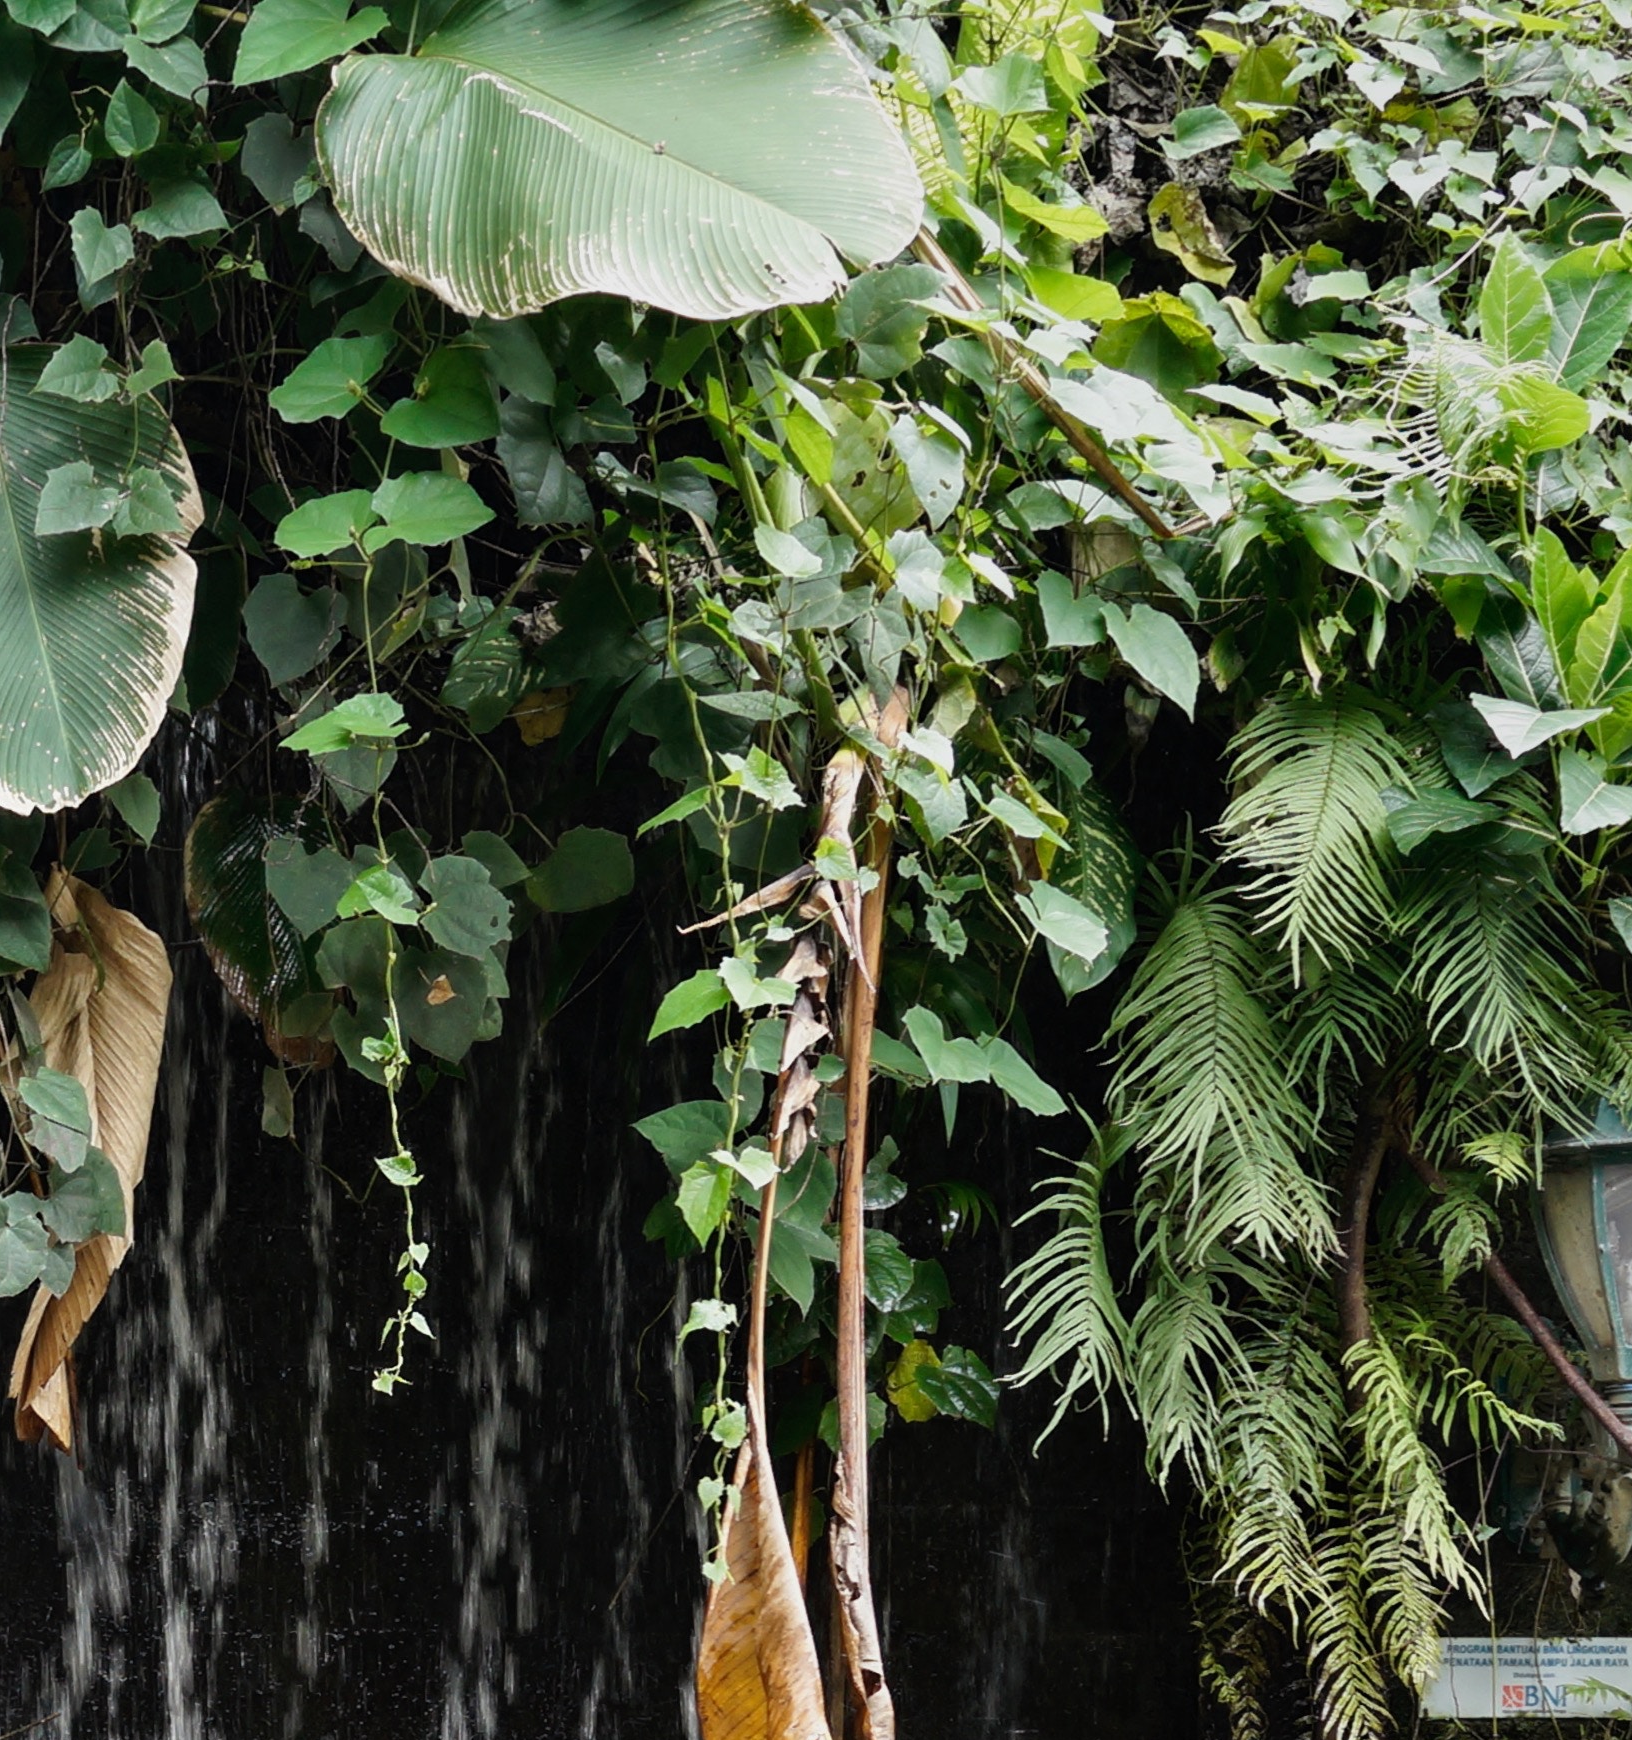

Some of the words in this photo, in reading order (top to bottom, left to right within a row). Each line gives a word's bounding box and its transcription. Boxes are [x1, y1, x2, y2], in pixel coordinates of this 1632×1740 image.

[1447, 1644, 1493, 1653] PROGRAM
[1497, 1644, 1540, 1654] BANTUAN
[1543, 1644, 1564, 1654] BINA
[1567, 1644, 1627, 1654] LINGKUNGAN
[1444, 1657, 1494, 1667] PENATAAN
[1569, 1657, 1601, 1667] JALAN
[1604, 1657, 1629, 1667] RAYA
[1525, 1685, 1567, 1707] BNI
